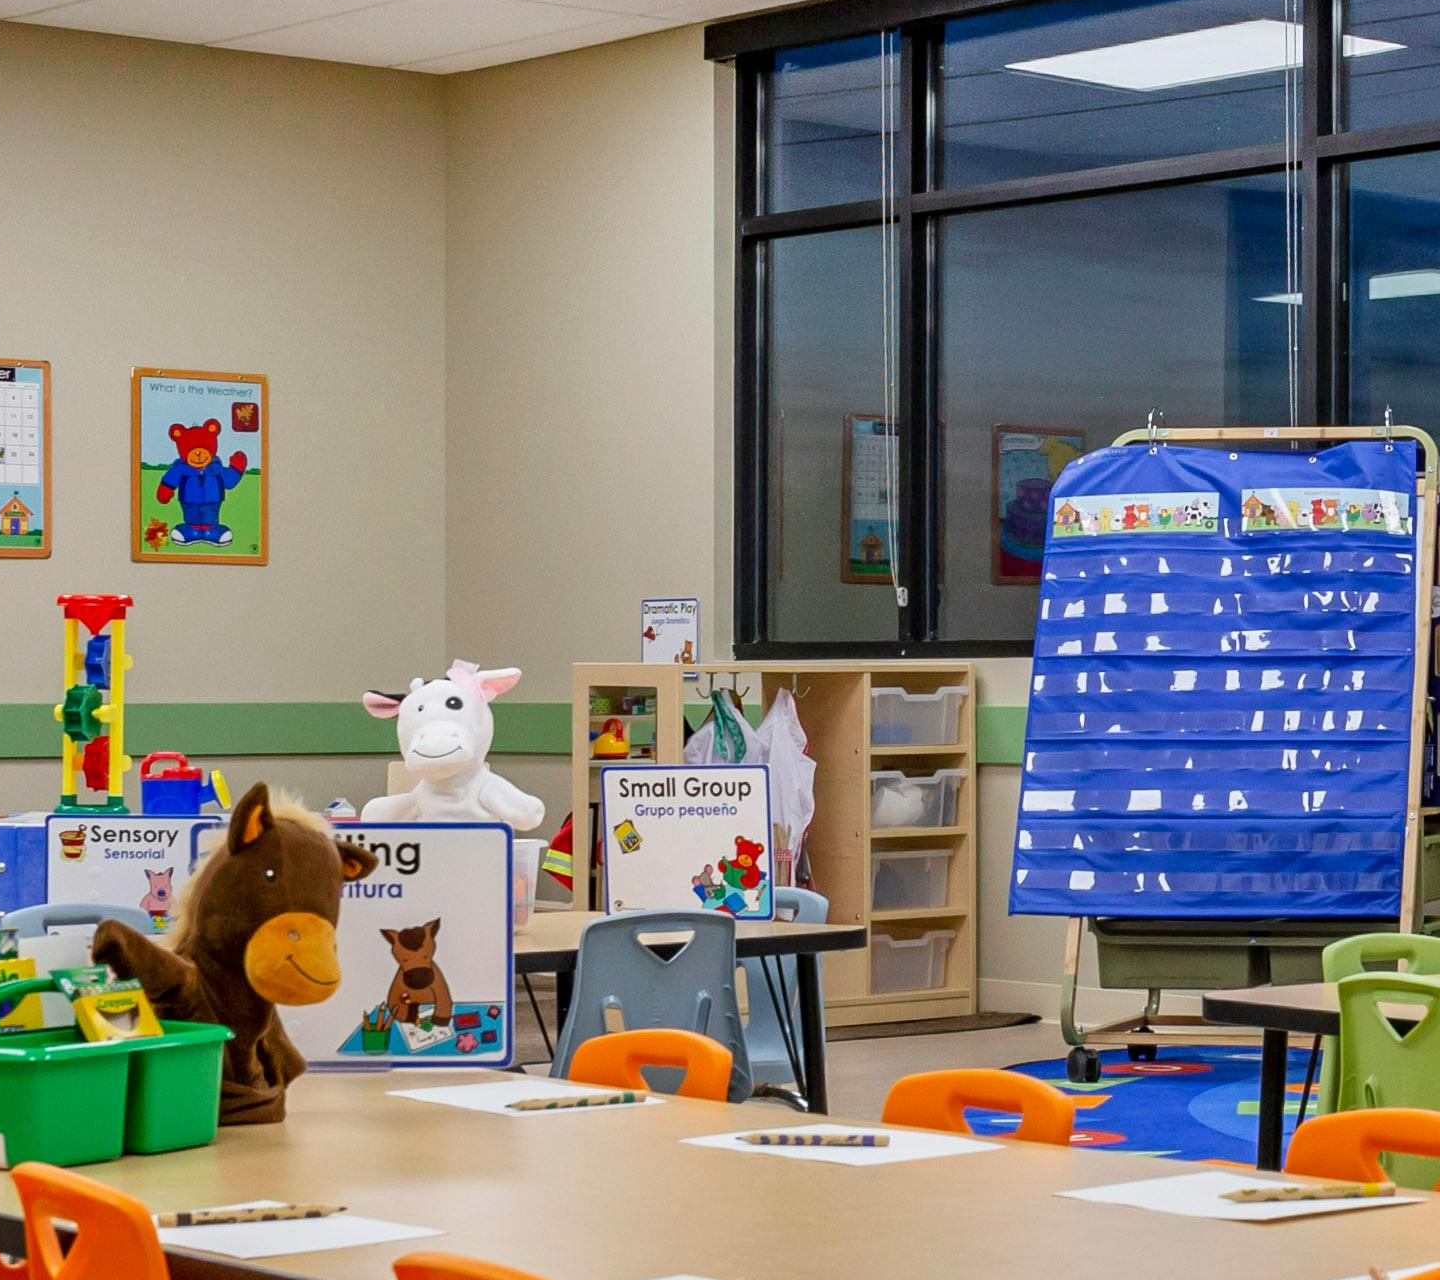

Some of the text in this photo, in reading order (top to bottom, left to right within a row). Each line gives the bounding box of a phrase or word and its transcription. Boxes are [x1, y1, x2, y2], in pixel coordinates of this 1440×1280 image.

[150, 383, 253, 398] What is the Weather?
[643, 602, 697, 616] Dramatic Play
[619, 777, 752, 804] Small Group
[634, 803, 738, 819] Grupo pequeño
[91, 824, 180, 847] Sensory
[104, 848, 165, 860] Sensorial
